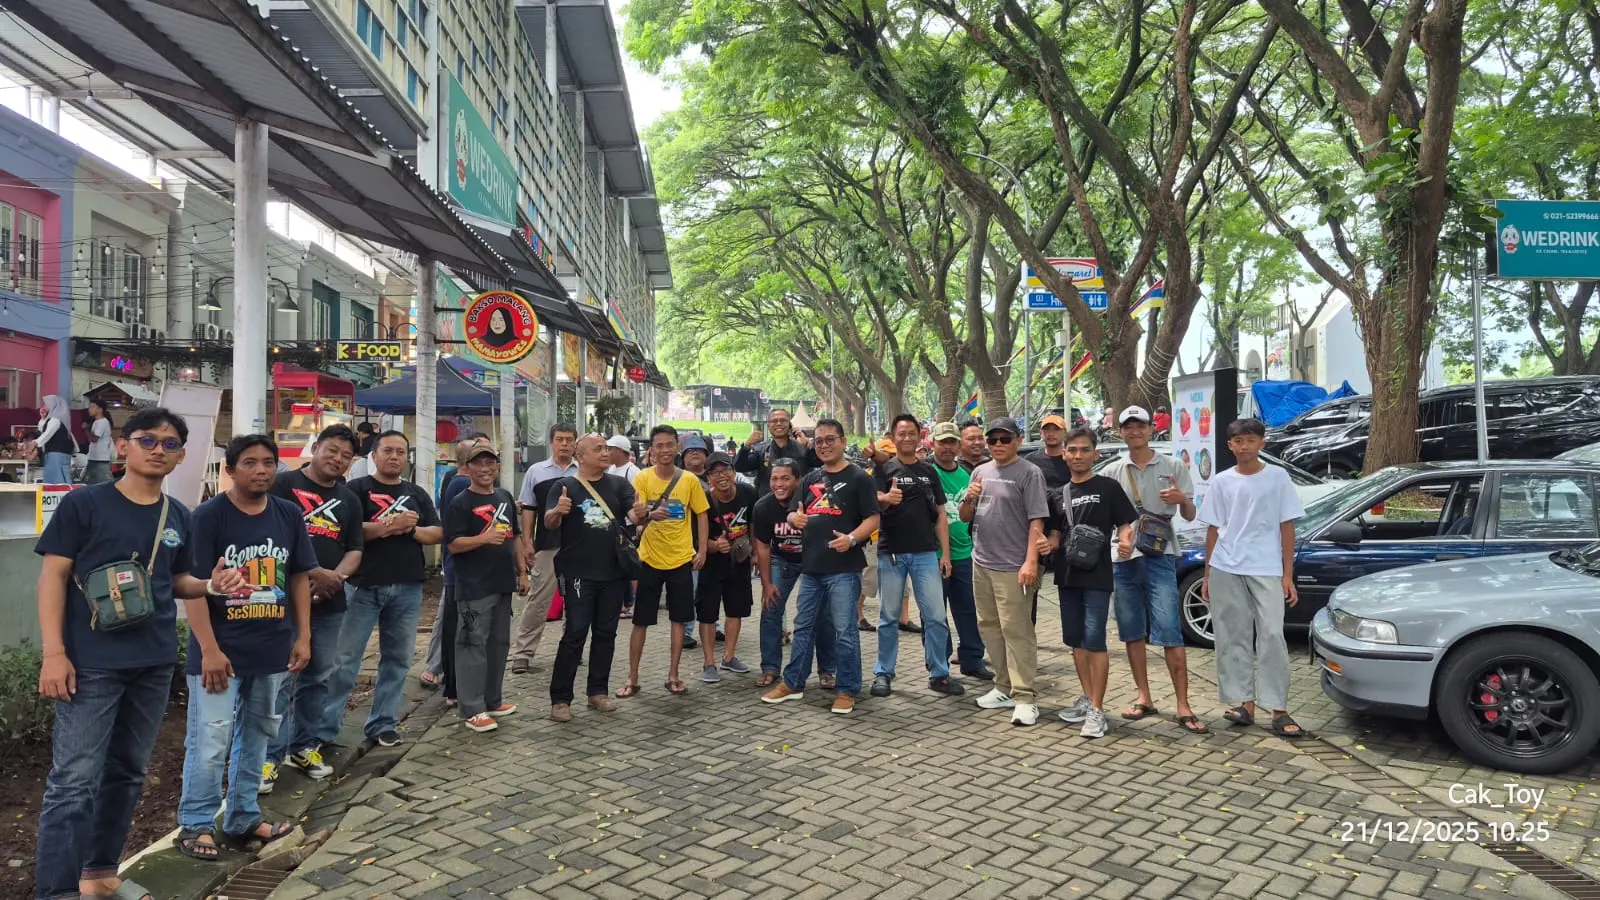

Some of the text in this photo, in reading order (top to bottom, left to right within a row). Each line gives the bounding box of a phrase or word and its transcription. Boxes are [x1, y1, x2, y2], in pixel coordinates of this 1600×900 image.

[470, 131, 513, 224] WEDRINK
[1521, 231, 1600, 247] WEDRINK
[469, 296, 494, 322] BAKSO
[497, 295, 531, 326] MALANG
[338, 344, 400, 360] K-FOOD
